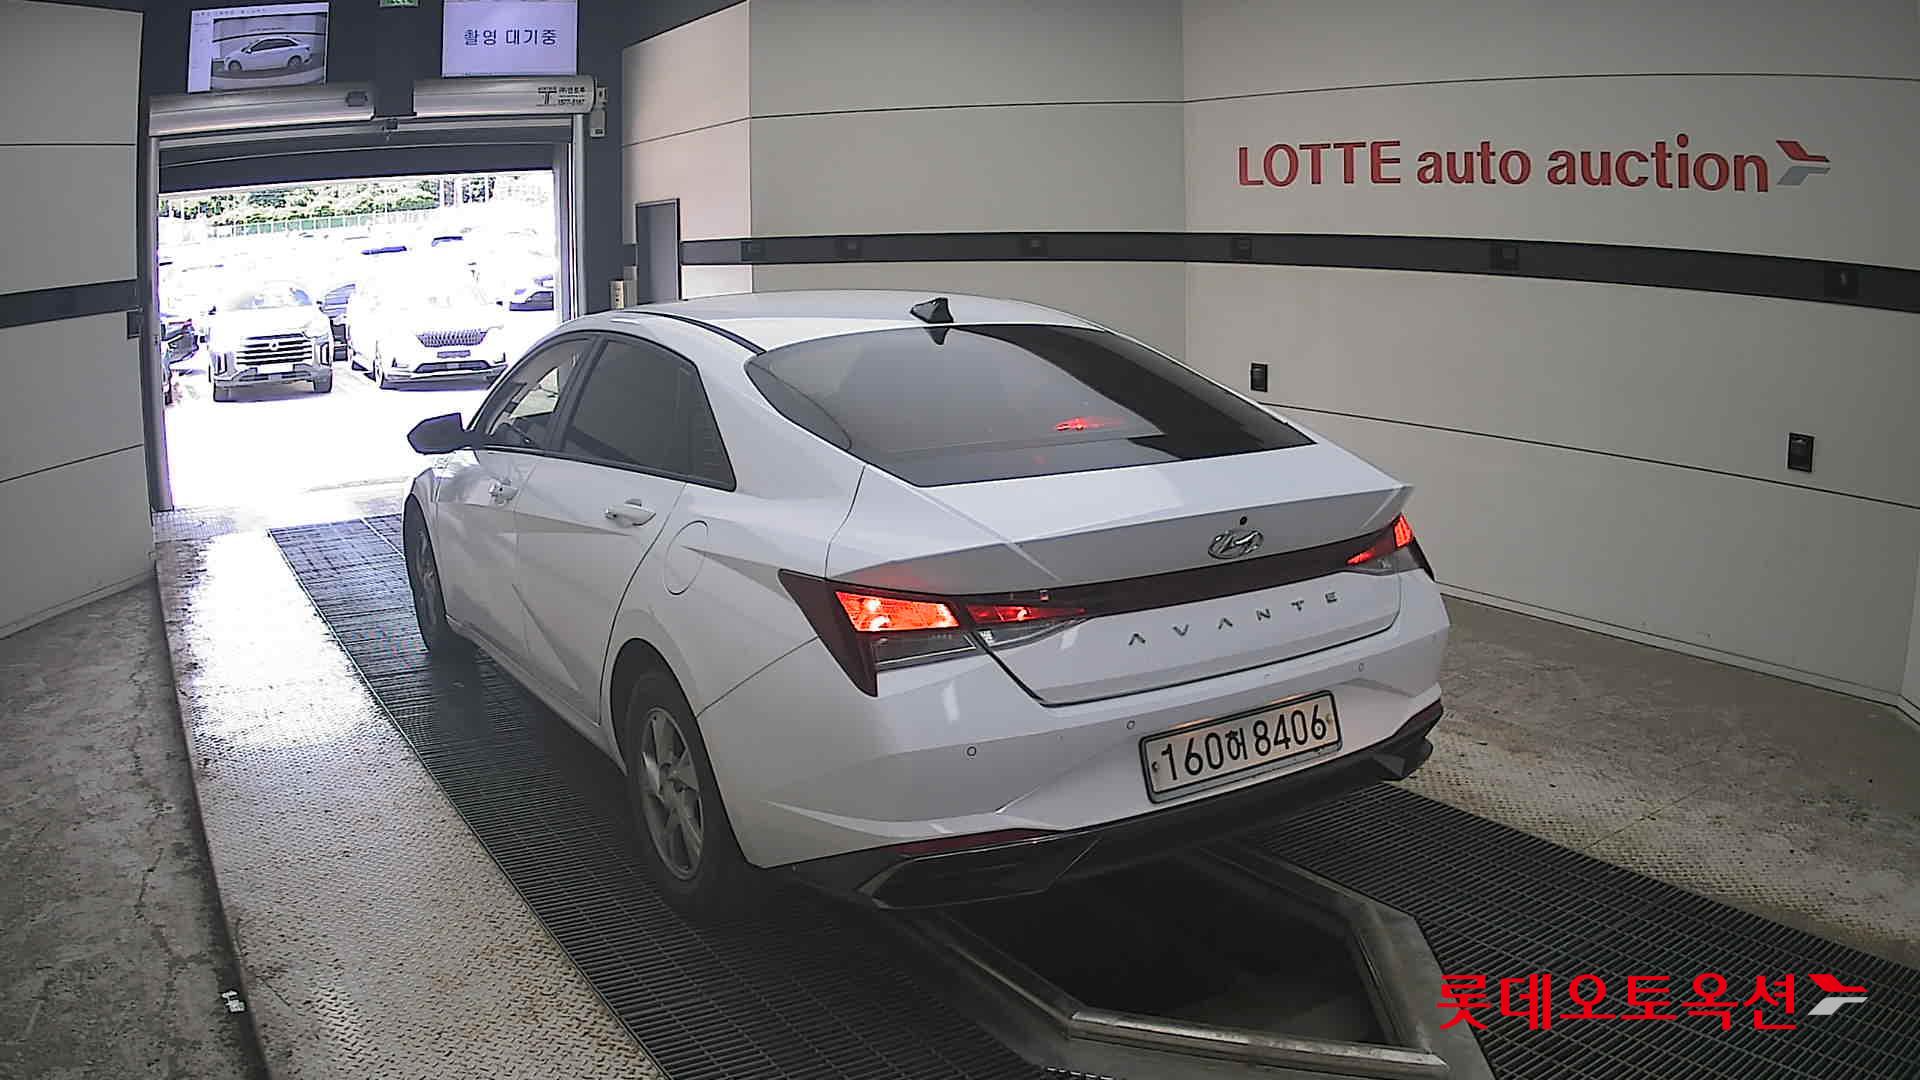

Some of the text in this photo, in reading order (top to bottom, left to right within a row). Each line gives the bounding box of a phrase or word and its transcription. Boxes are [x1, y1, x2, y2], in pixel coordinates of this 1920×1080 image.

[464, 29, 557, 46] 촬영 대기중
[1238, 133, 1769, 193] LOTTE auto auction
[1128, 591, 1337, 646] AVANTE
